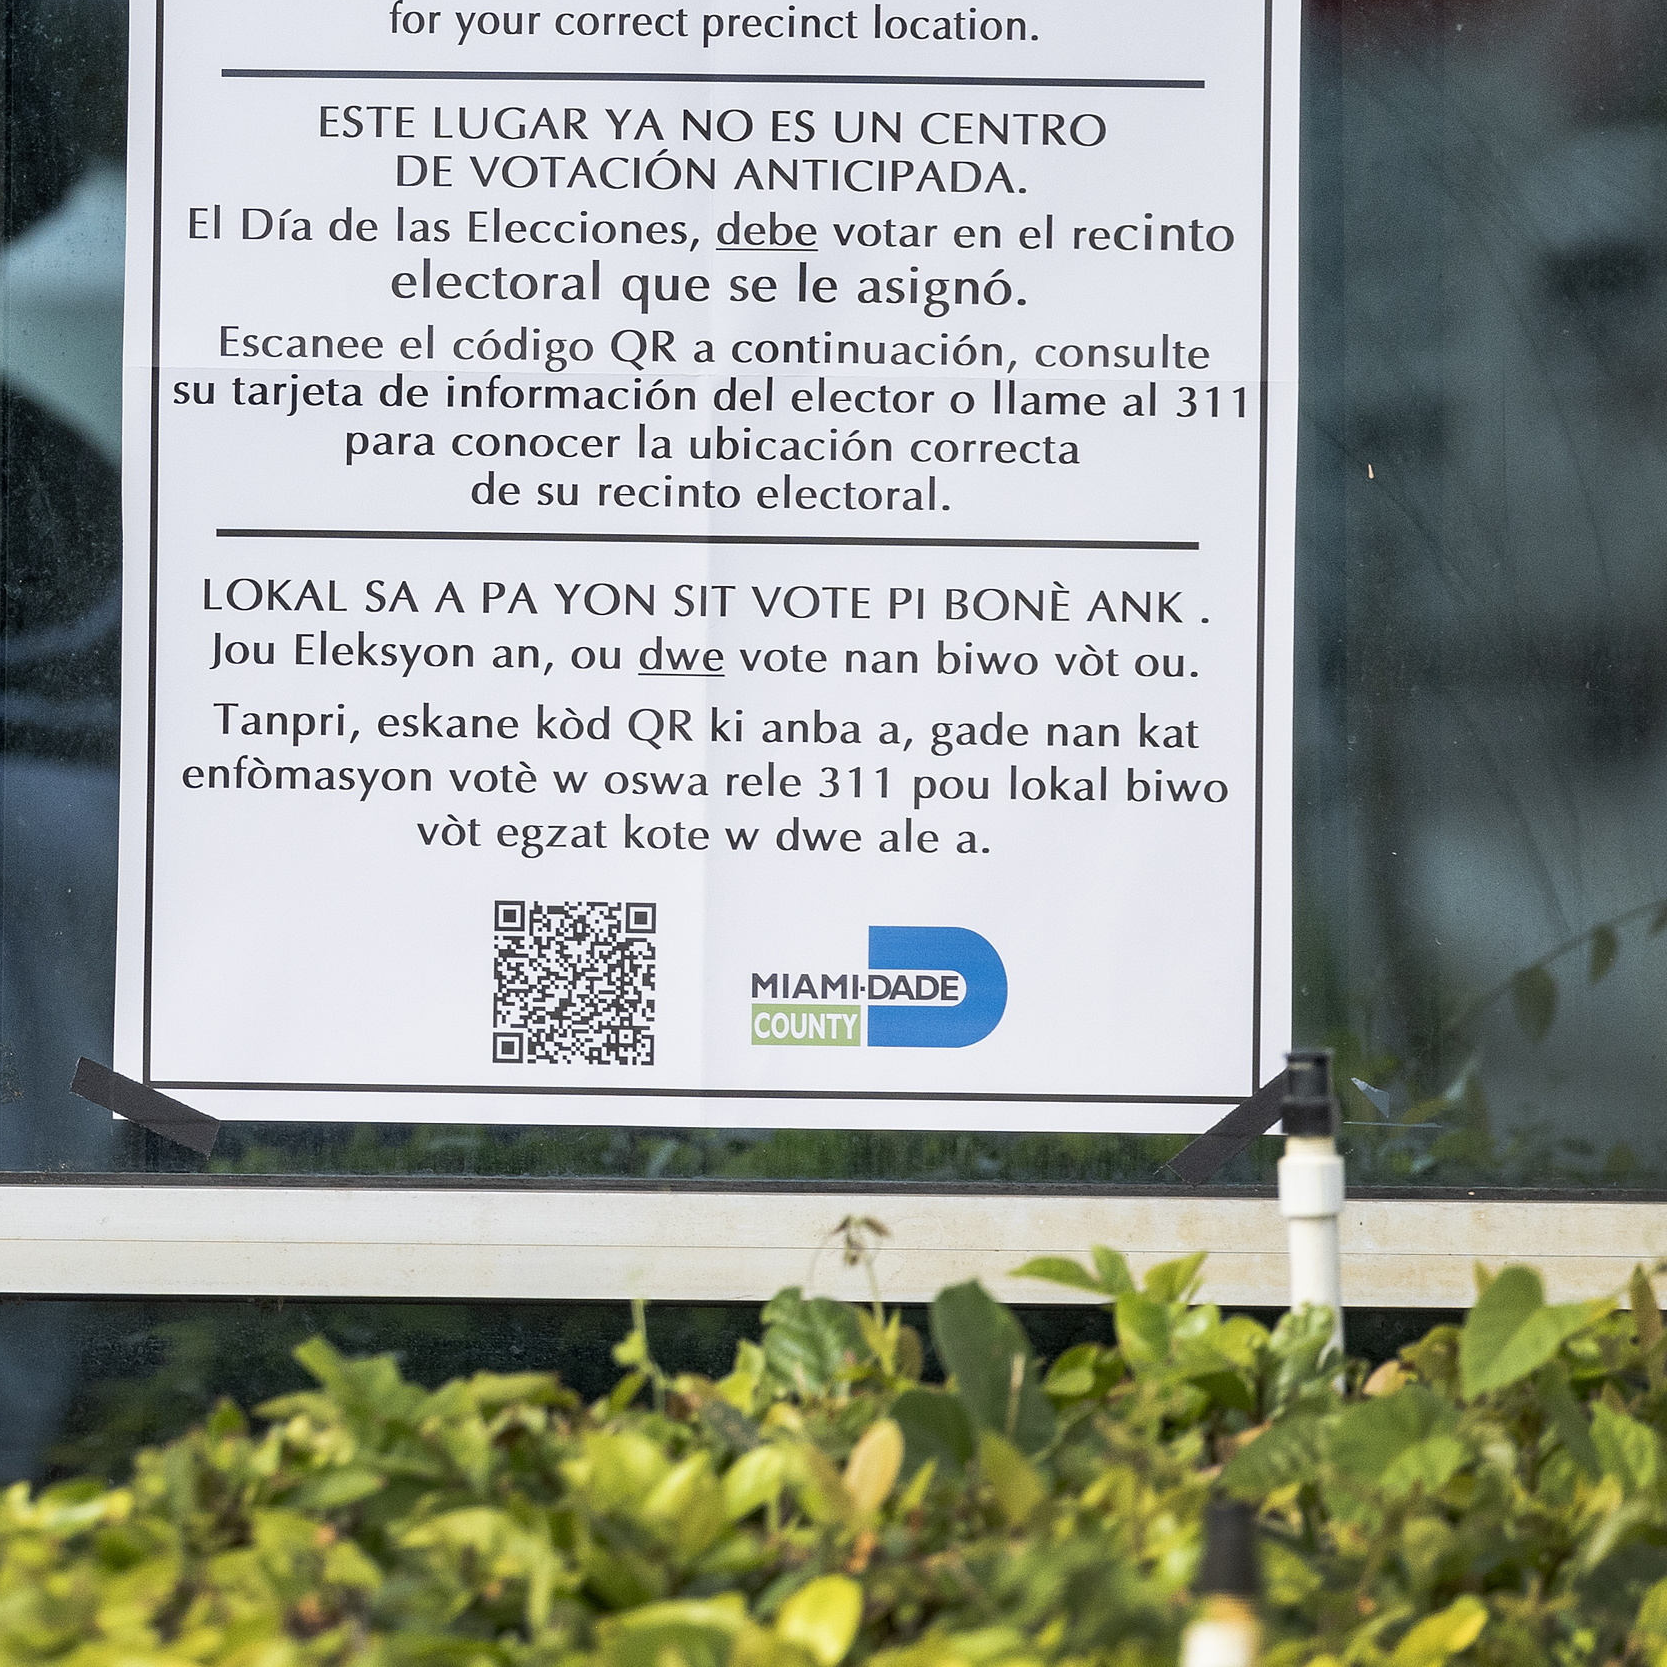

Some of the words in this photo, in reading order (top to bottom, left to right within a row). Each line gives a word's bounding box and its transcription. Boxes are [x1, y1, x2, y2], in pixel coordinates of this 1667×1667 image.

[389, 0, 441, 34] for
[455, 12, 540, 45] your
[555, 9, 688, 37] correct
[703, 5, 858, 48] precinct
[875, 4, 1038, 41] location.
[397, 155, 452, 186] DE
[470, 149, 715, 190] VOTACIÓN
[734, 158, 1026, 193] ANTICIPADA.
[392, 258, 599, 300] electoral
[622, 275, 709, 314] que
[730, 276, 777, 302] se
[799, 262, 837, 303] le
[858, 266, 1026, 317] asignó.
[221, 326, 383, 359] Escanee
[400, 325, 433, 359] el
[453, 326, 593, 372] código
[611, 330, 676, 371] QR
[694, 341, 715, 363] a
[732, 331, 1016, 373] continuación,
[1036, 334, 1209, 369] consulte
[174, 382, 214, 404] su
[232, 374, 363, 416] tarjeta
[380, 373, 428, 407] de
[447, 375, 695, 410] información
[714, 377, 773, 411] del
[792, 377, 934, 413] elector
[950, 392, 974, 414] o
[994, 380, 1106, 416] llame
[1123, 382, 1156, 416] al
[1177, 387, 1245, 418] 311
[346, 432, 435, 465] para
[452, 434, 620, 458] conocer
[639, 423, 672, 459] la
[690, 426, 891, 461] ubicación
[911, 436, 1080, 464] correcta
[472, 471, 520, 505] de
[537, 483, 578, 505] su
[599, 475, 740, 508] recinto
[757, 474, 950, 510] electoral.
[204, 578, 347, 611] LOKAL
[366, 580, 419, 612] SA
[434, 582, 465, 613] A
[483, 582, 538, 614] PA
[554, 583, 654, 615] YON
[674, 585, 736, 617] SIT
[751, 586, 870, 618] VOTE
[890, 588, 924, 619] PI
[946, 581, 1069, 621] BONÈ
[1087, 591, 1183, 623] ANK
[213, 703, 359, 746] Tanpri,
[378, 702, 518, 739] eskane
[537, 704, 609, 739] kòd
[628, 709, 693, 750] QR
[712, 707, 743, 742] ki
[762, 709, 861, 744] anba
[879, 722, 912, 751] a,
[931, 711, 1028, 756] gade
[1048, 724, 1119, 747] nan
[1140, 713, 1199, 748] kat
[417, 814, 481, 846] vòt
[497, 821, 607, 858] egzat
[625, 814, 709, 850] kote
[725, 828, 759, 850] w
[776, 817, 861, 852] dwe
[879, 818, 938, 853] ale
[957, 832, 989, 853] a.
[752, 973, 959, 1001] MIAMI-DADE
[754, 1012, 858, 1040] COUNTY
